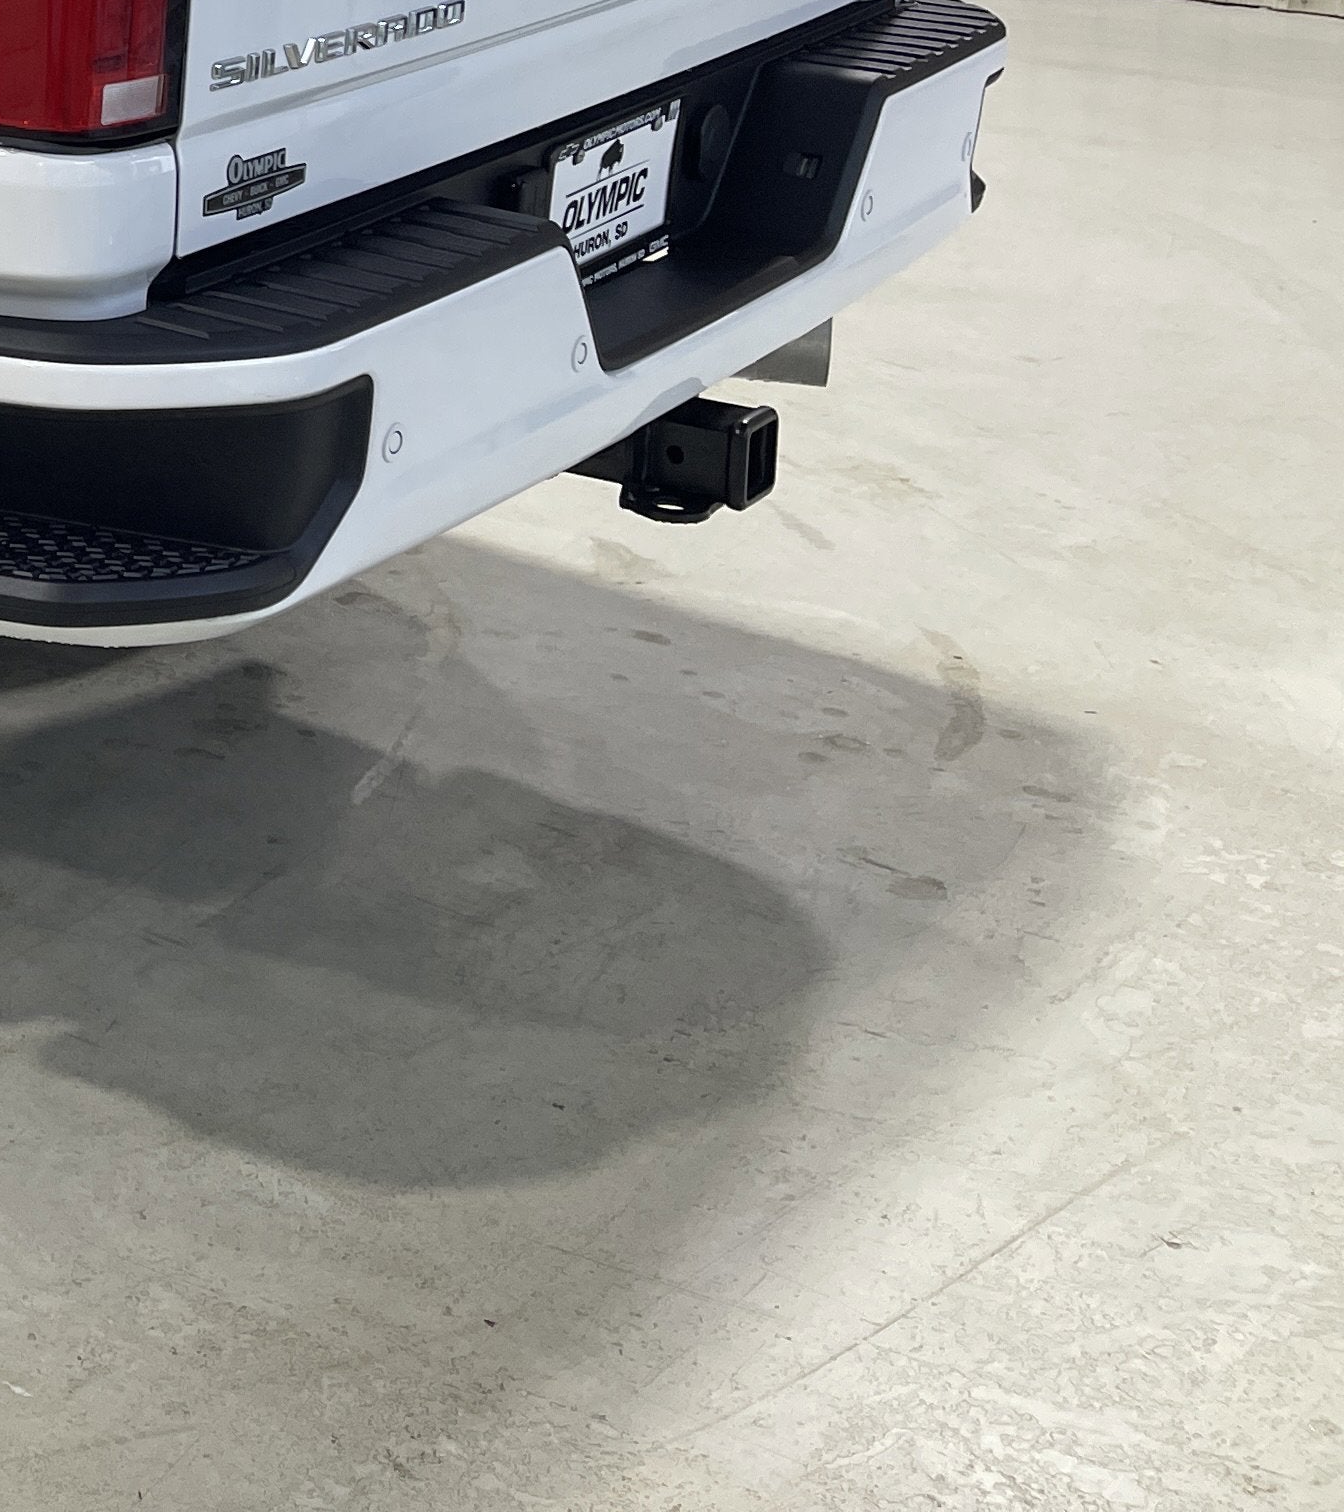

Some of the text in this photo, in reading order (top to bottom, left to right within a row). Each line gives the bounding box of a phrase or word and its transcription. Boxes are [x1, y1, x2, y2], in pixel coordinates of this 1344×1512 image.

[228, 150, 286, 185] OLYMPIC
[562, 167, 649, 233] OLYMPIC
[615, 221, 628, 239] SD
